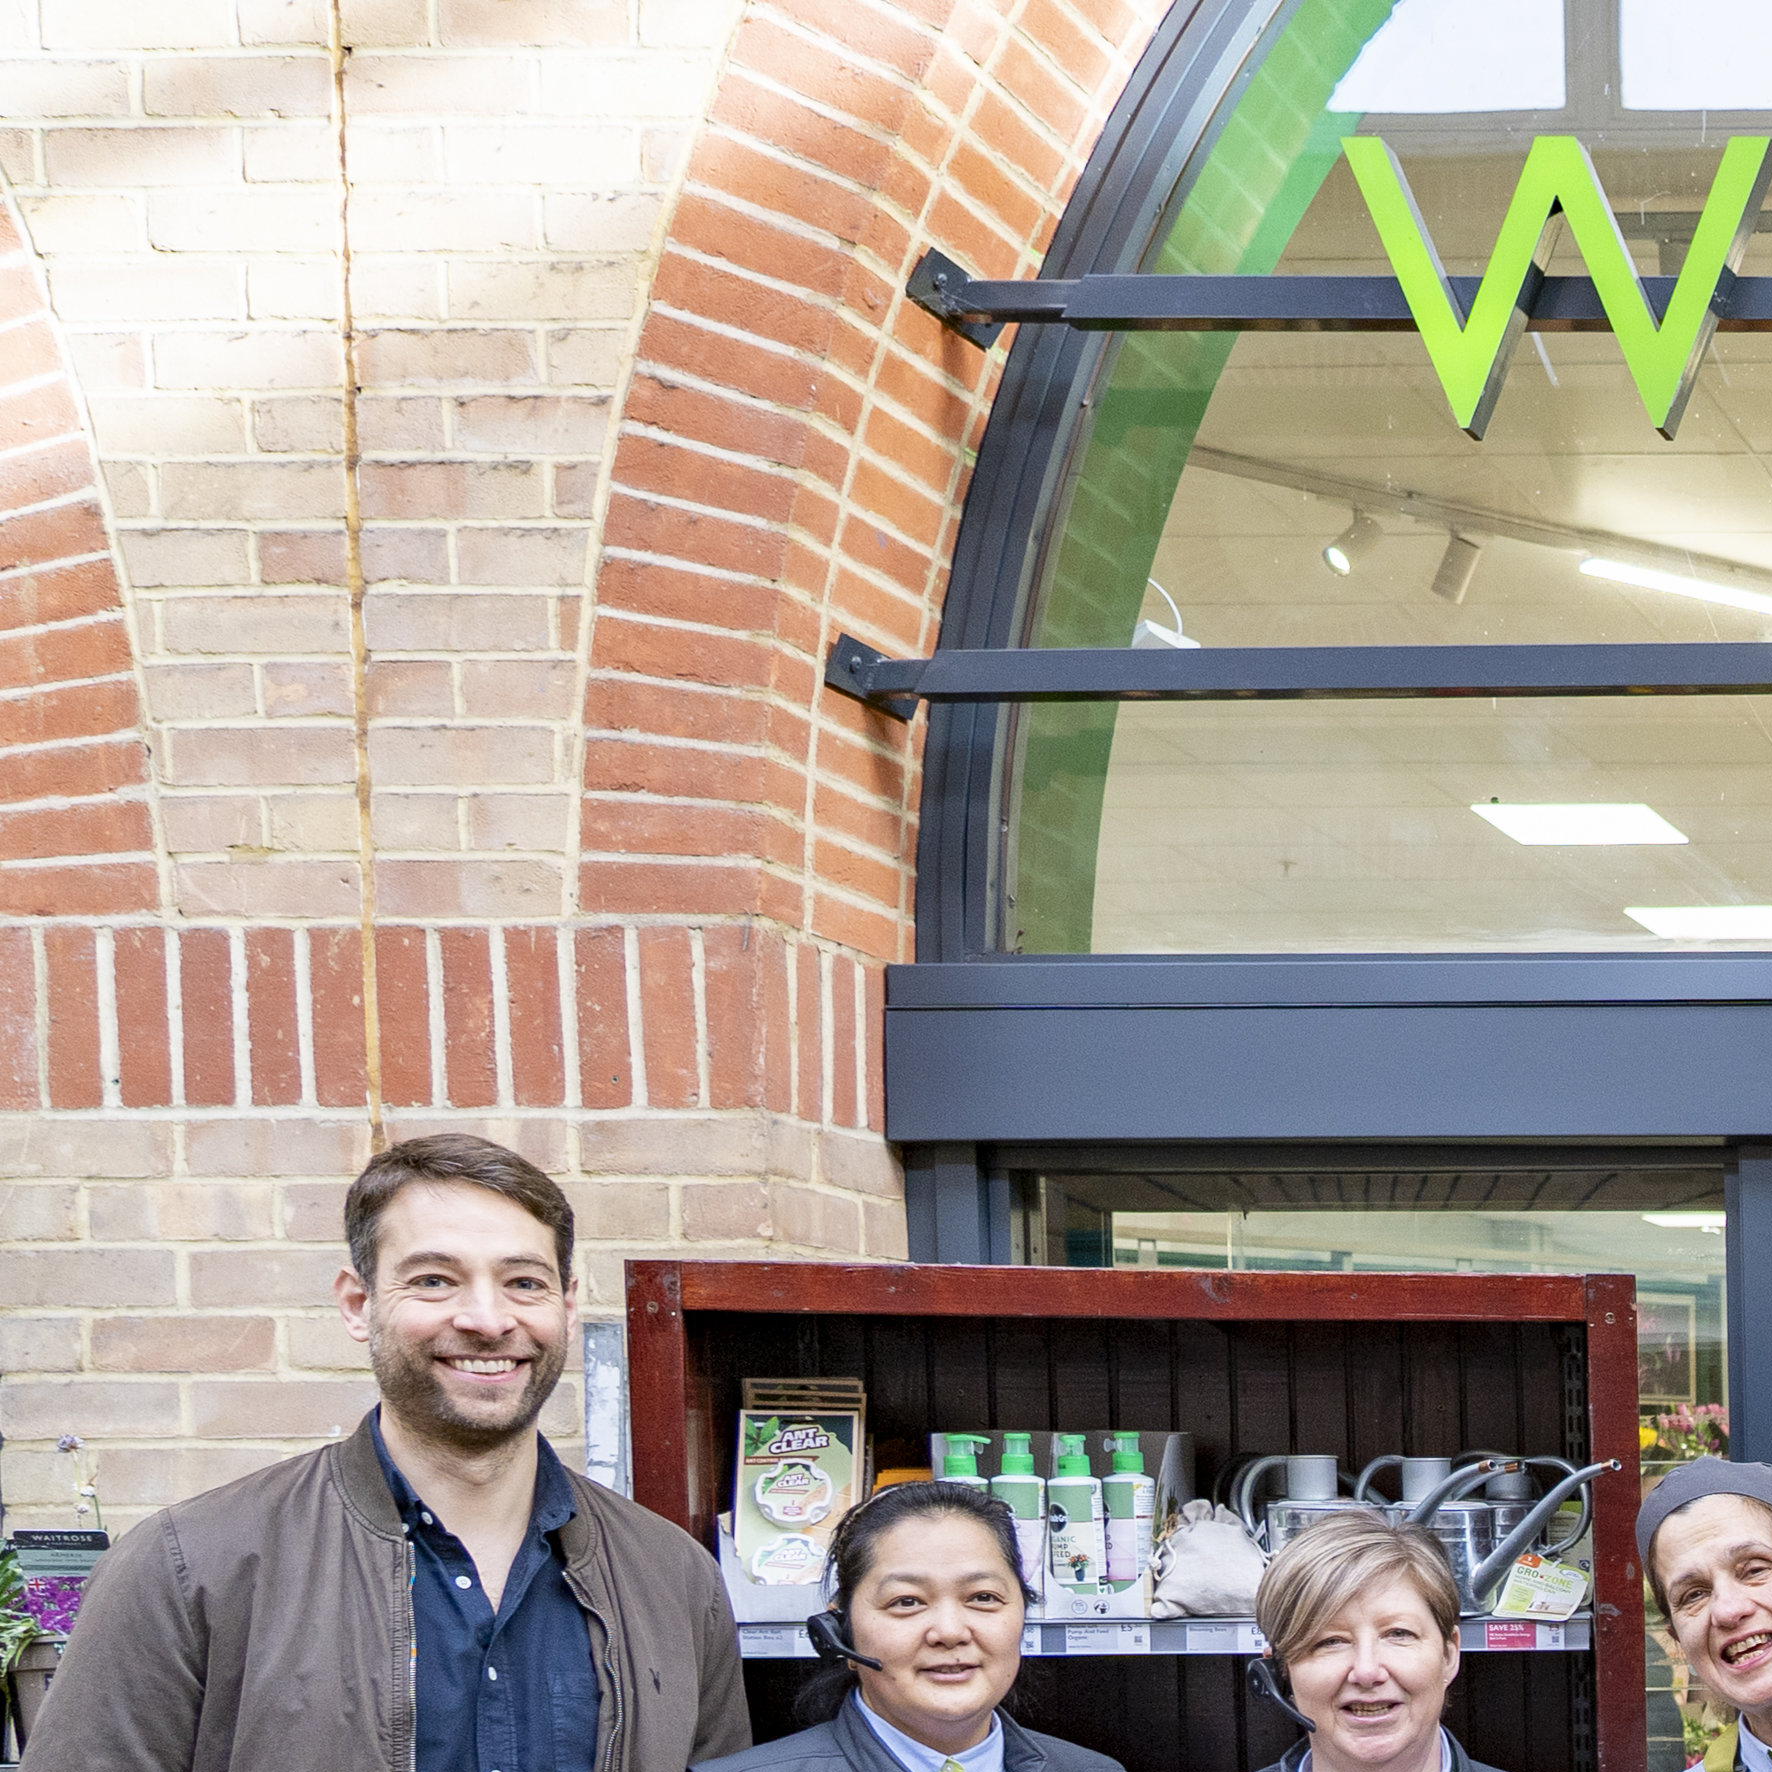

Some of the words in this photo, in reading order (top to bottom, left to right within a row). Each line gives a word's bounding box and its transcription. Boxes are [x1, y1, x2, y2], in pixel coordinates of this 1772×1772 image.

[780, 1427, 819, 1443] ANT
[769, 1434, 829, 1454] CLEAR
[776, 1477, 810, 1488] CLEAR
[783, 1473, 804, 1482] ANT
[1516, 1566, 1540, 1579] GRO
[1544, 1575, 1574, 1590] ZONE
[1489, 1624, 1508, 1632] SAVE
